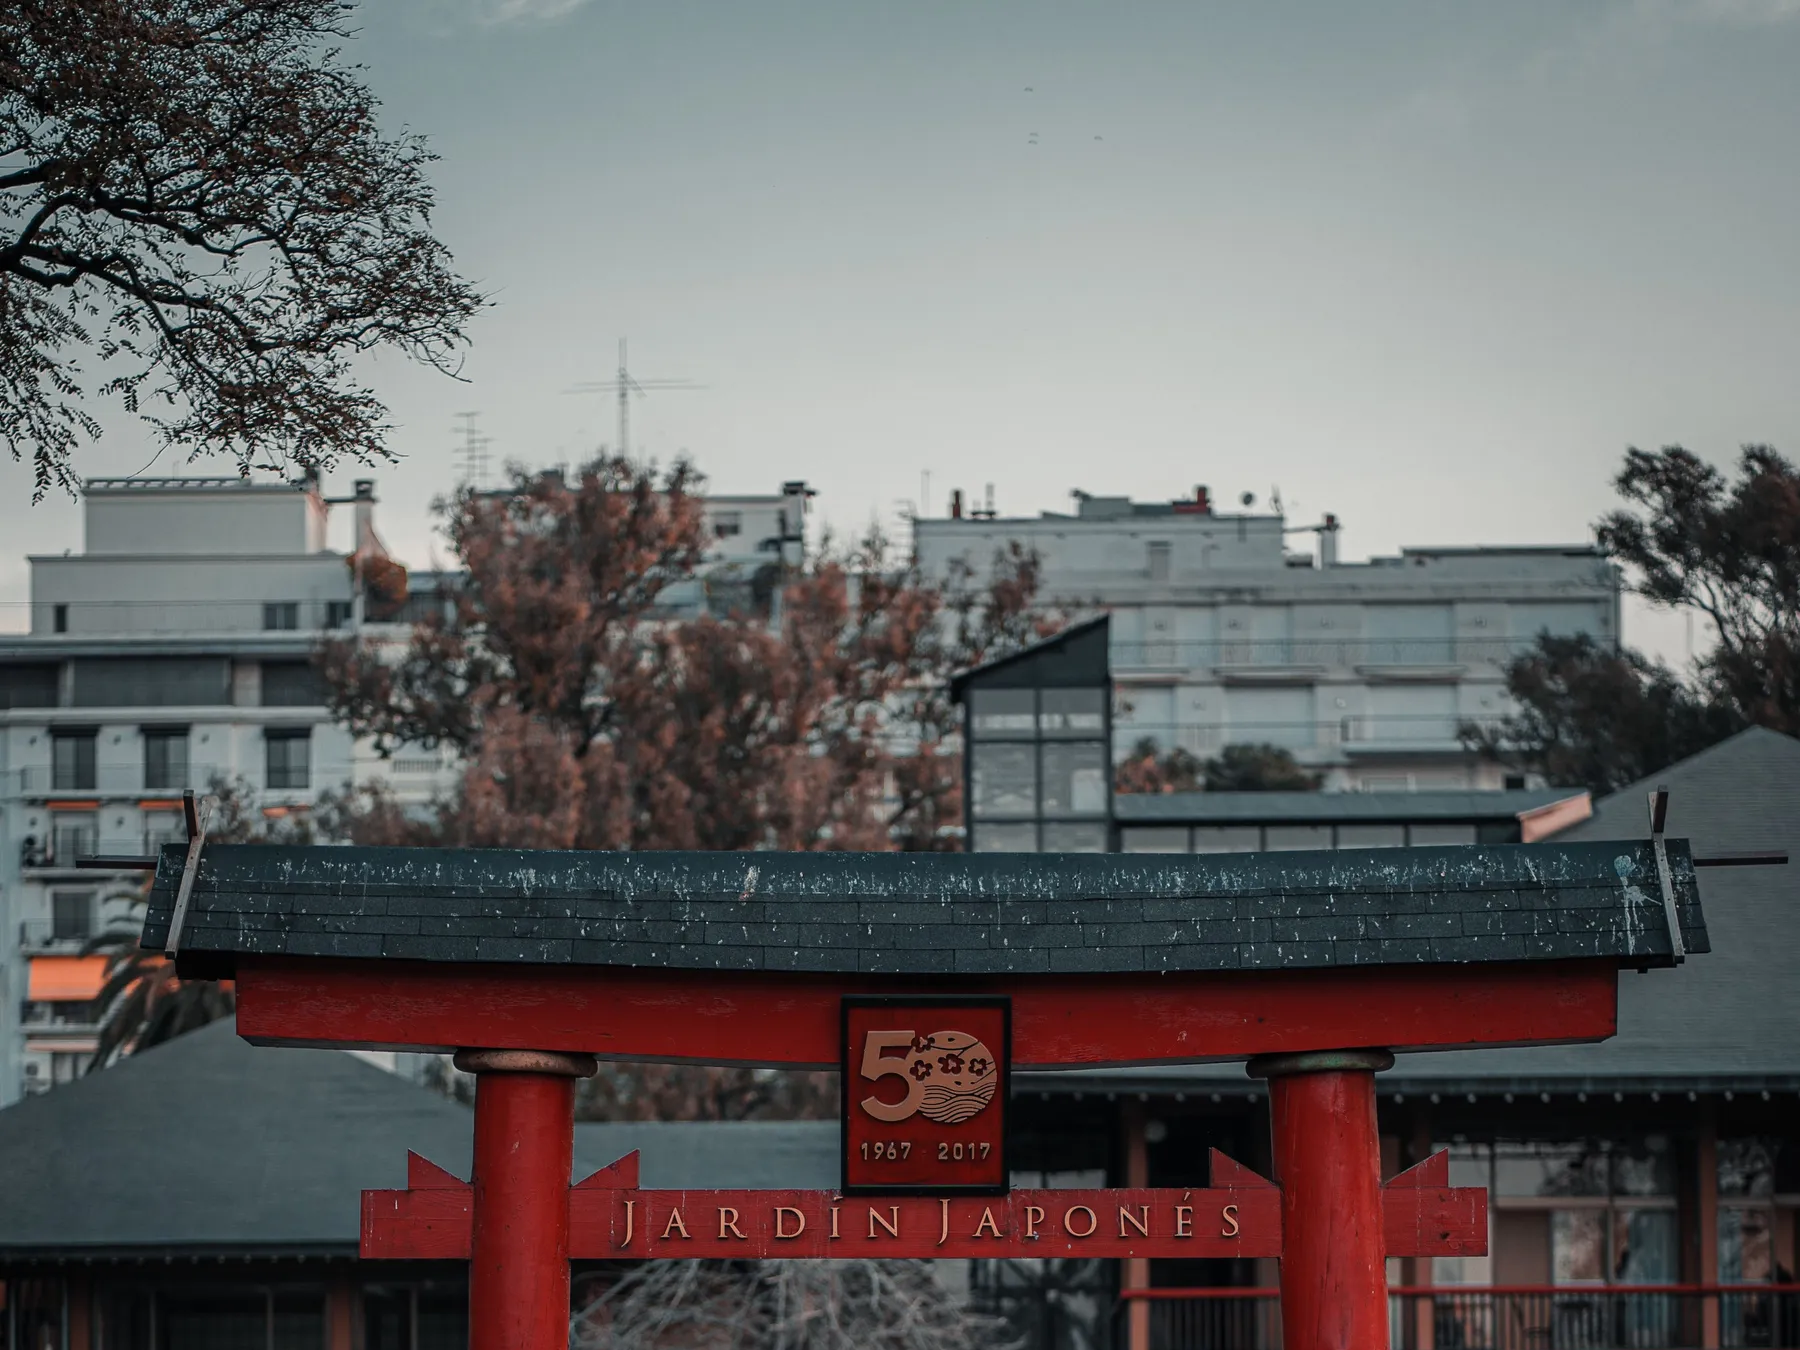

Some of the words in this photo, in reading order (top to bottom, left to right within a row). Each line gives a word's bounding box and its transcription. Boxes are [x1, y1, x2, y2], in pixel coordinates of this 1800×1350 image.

[859, 1030, 998, 1123] 50
[860, 1142, 912, 1160] 1967
[937, 1142, 992, 1160] 2017
[621, 1195, 900, 1247] JARDÍN
[938, 1191, 1239, 1246] JAPONÉS
